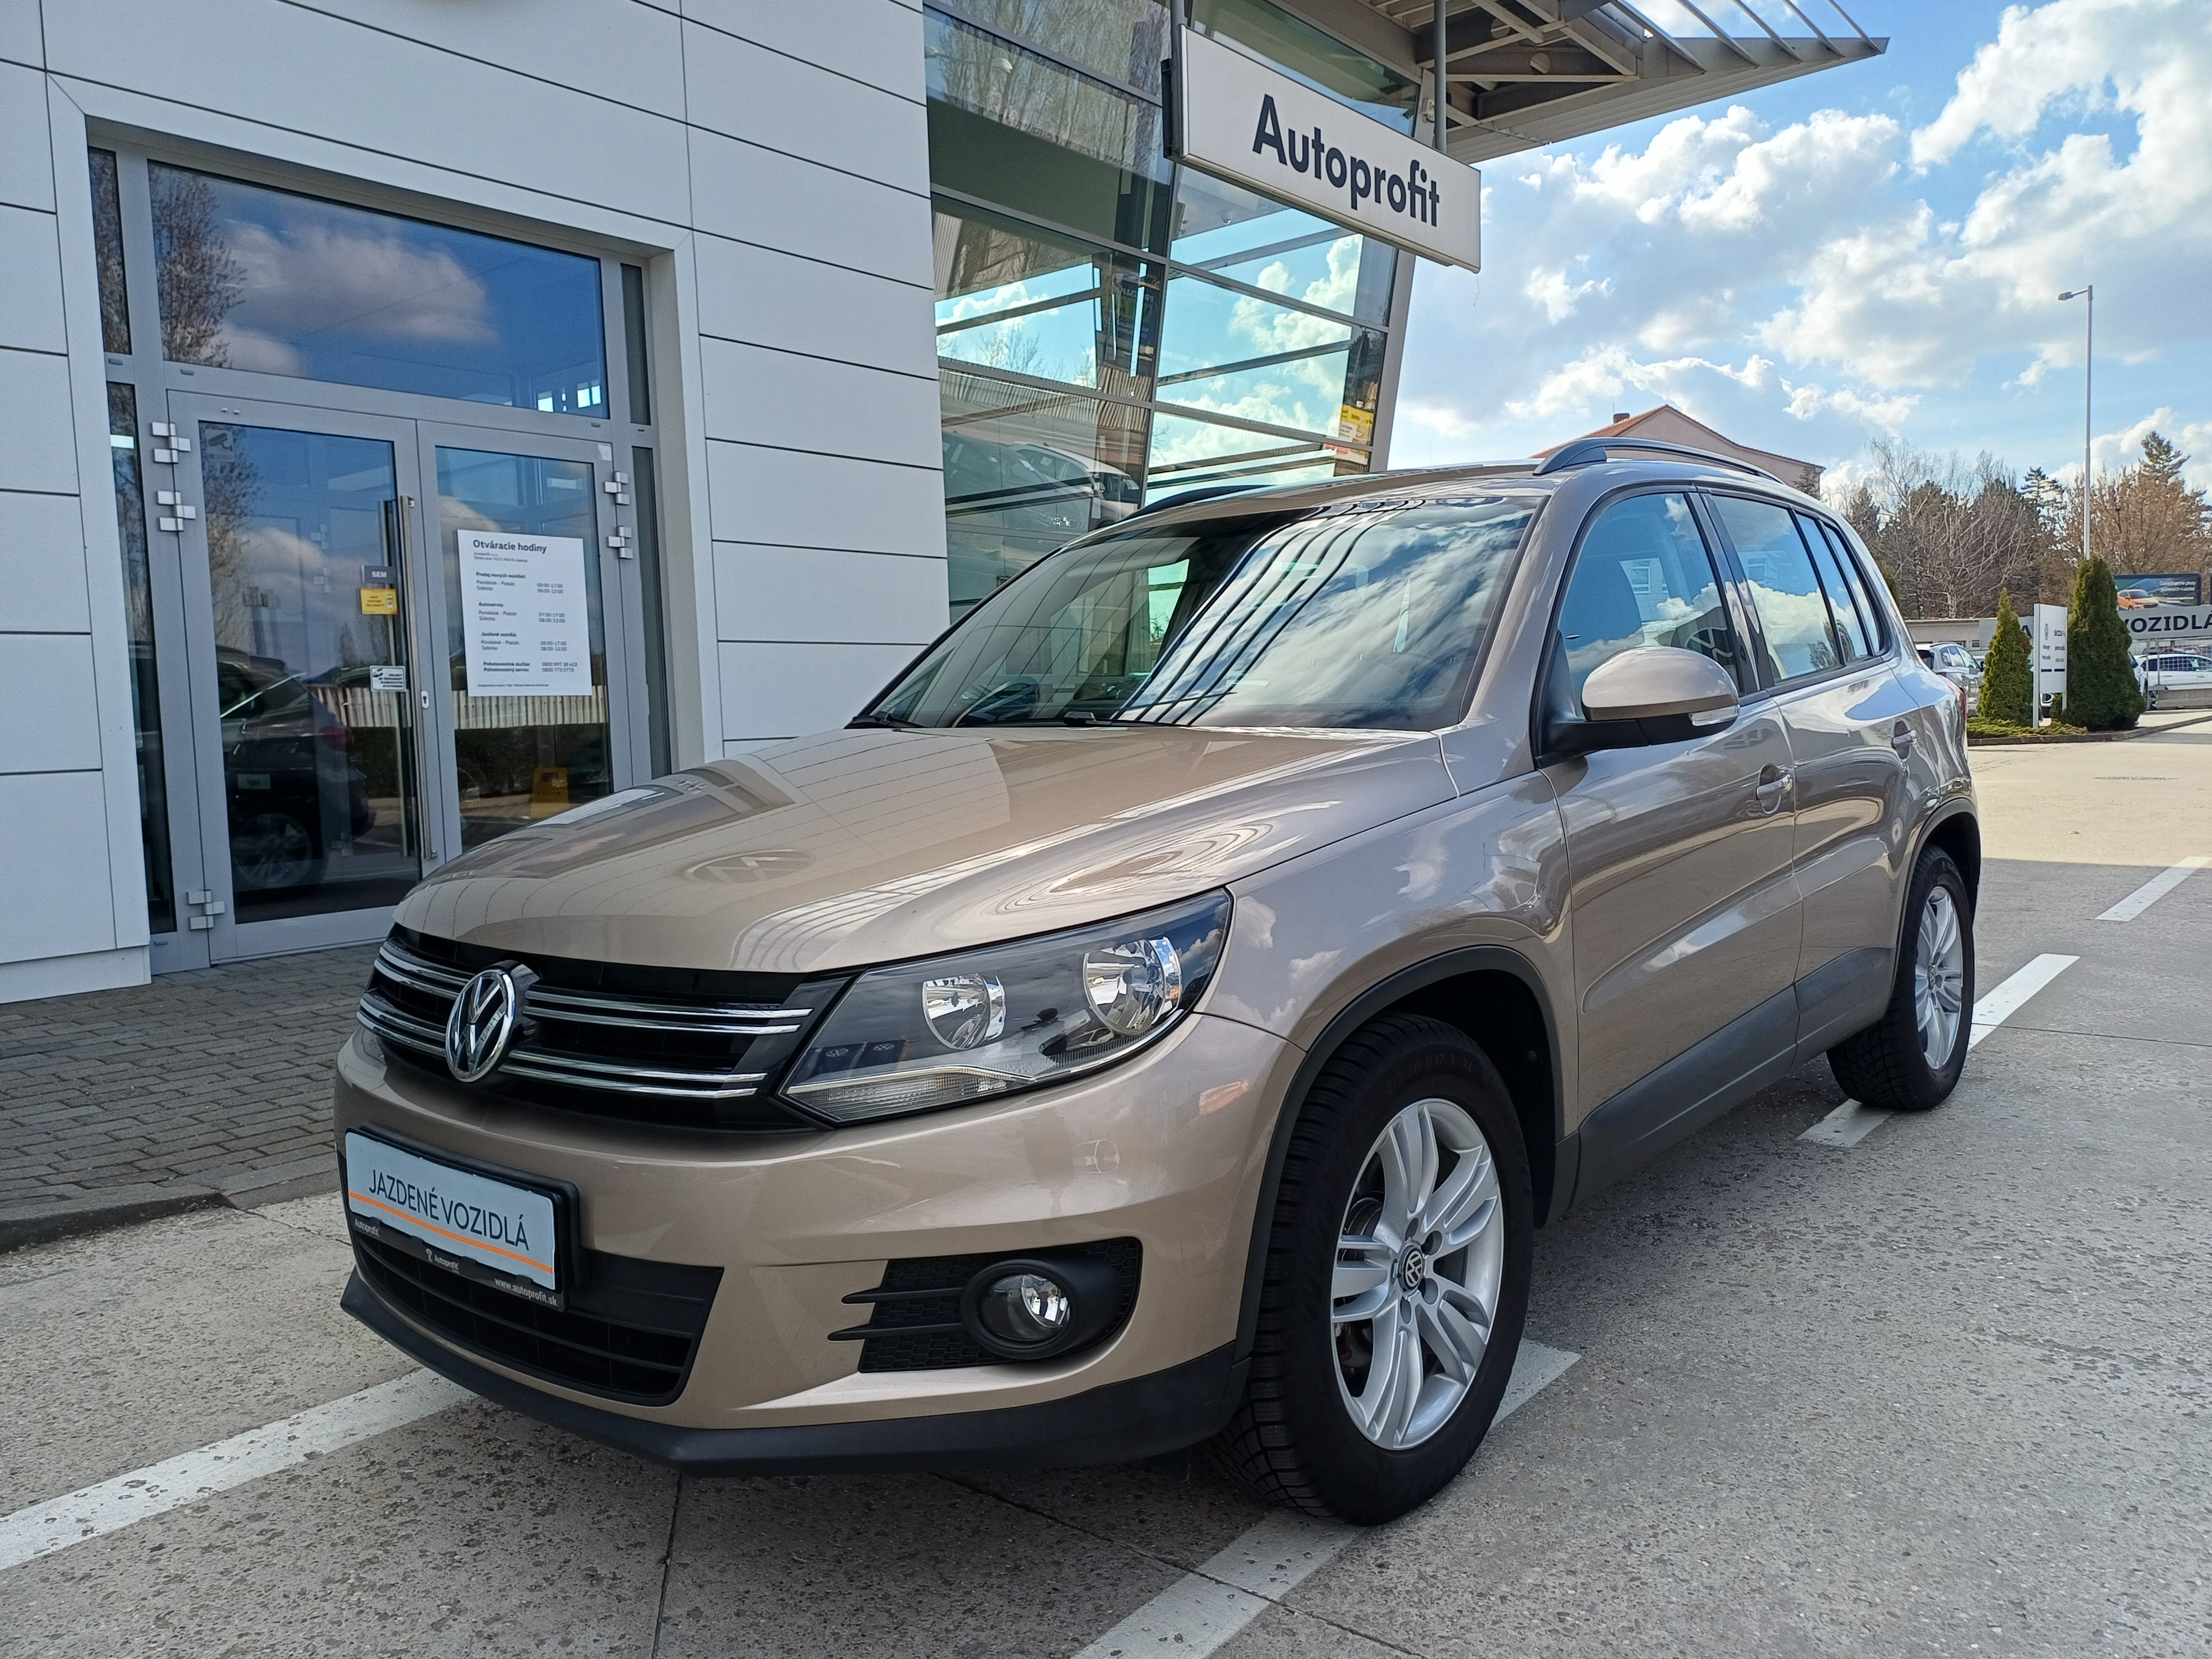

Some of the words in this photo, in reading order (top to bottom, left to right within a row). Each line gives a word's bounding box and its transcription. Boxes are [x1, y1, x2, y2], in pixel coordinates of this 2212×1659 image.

[1252, 93, 1439, 227] Autoprofit
[473, 539, 516, 550] Otváracie
[518, 542, 547, 554] hodiny
[368, 1169, 440, 1221] JAZDENÉ
[440, 1197, 529, 1251] VOZIDLÁ
[494, 1277, 558, 1307] www.autoprofit.sk
